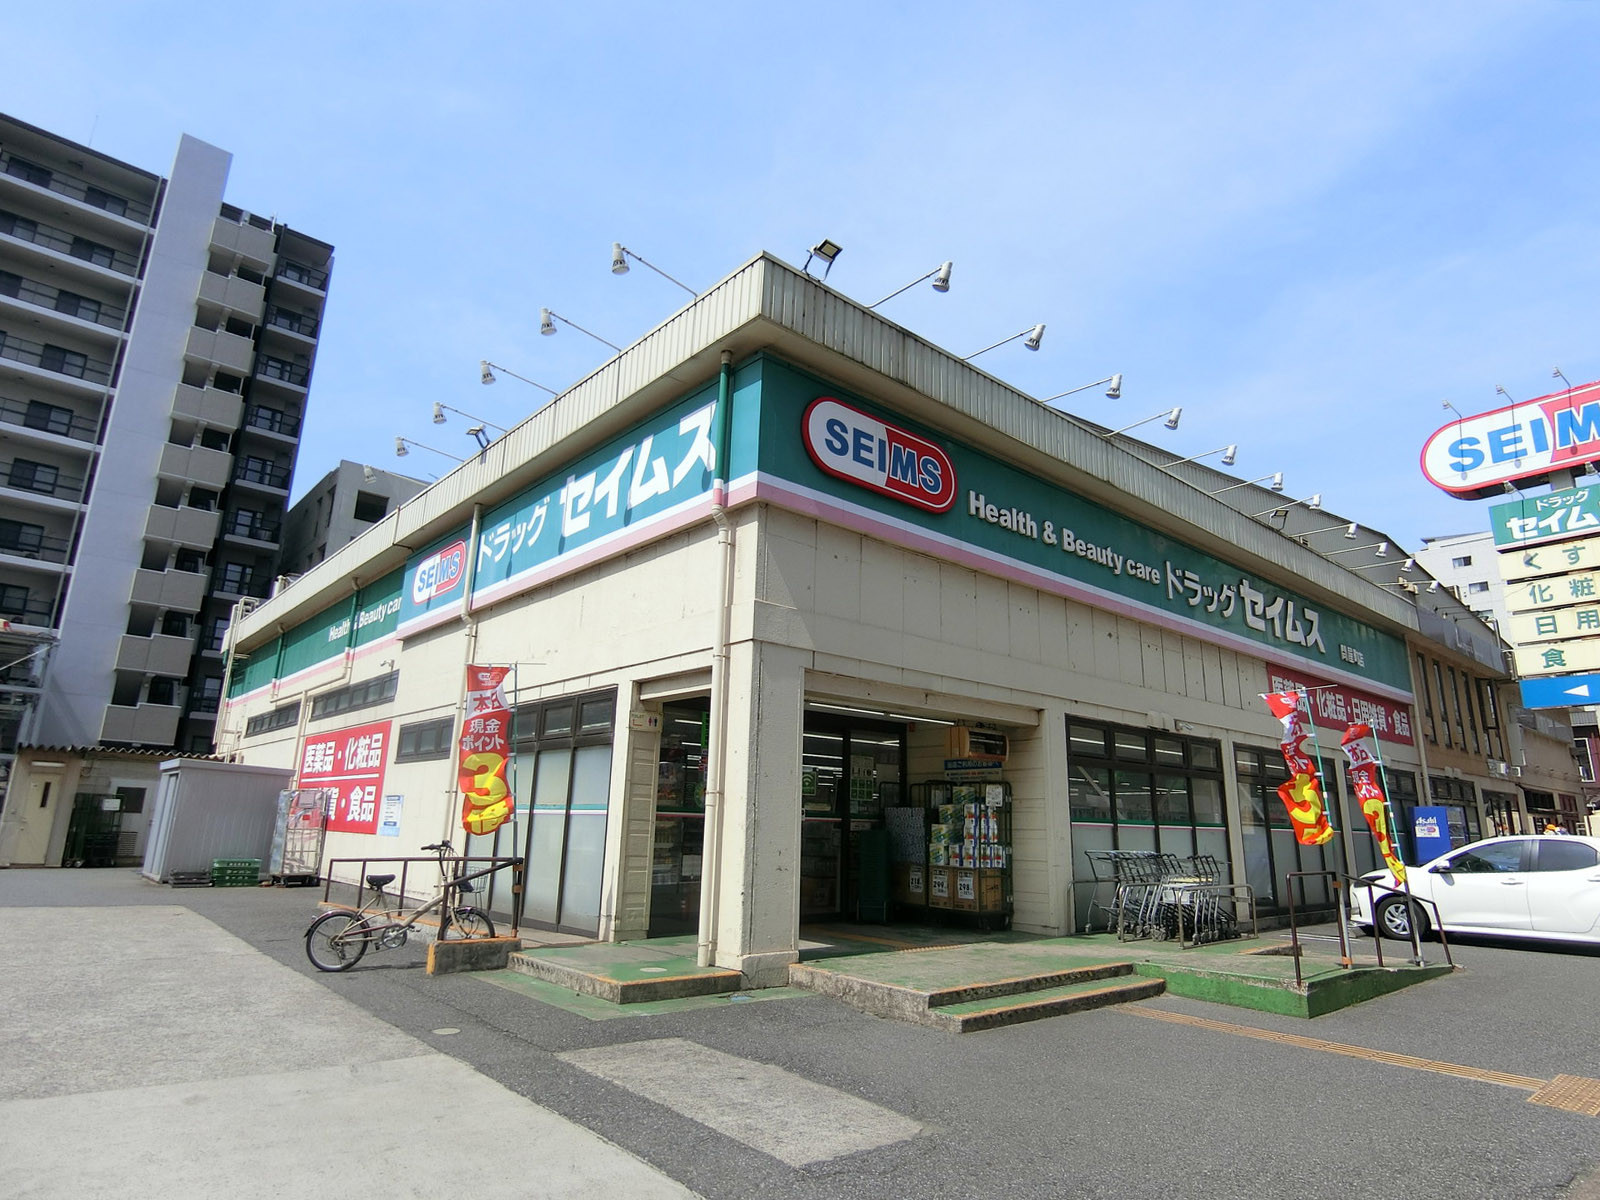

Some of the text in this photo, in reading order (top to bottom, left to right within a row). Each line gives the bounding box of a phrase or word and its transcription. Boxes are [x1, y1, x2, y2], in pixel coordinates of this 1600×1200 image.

[825, 418, 943, 495] SEIMS
[477, 400, 716, 572] ドラッグ セイムス
[1536, 489, 1590, 512] ドラッグ
[968, 490, 1161, 585] Health & Beauty care
[1506, 505, 1600, 540] セイム
[417, 550, 461, 593] SEIMS
[1524, 546, 1585, 571] くす
[1529, 577, 1595, 604] 化粧
[358, 602, 387, 629] Beauty
[1166, 560, 1326, 654] ドラッグ セイムス
[1535, 609, 1600, 635] 日用
[1541, 648, 1567, 668] 食
[469, 718, 501, 733] 現金
[303, 733, 384, 773] 医薬品・化粧品
[463, 734, 504, 751] ポイント
[462, 752, 507, 806] 3
